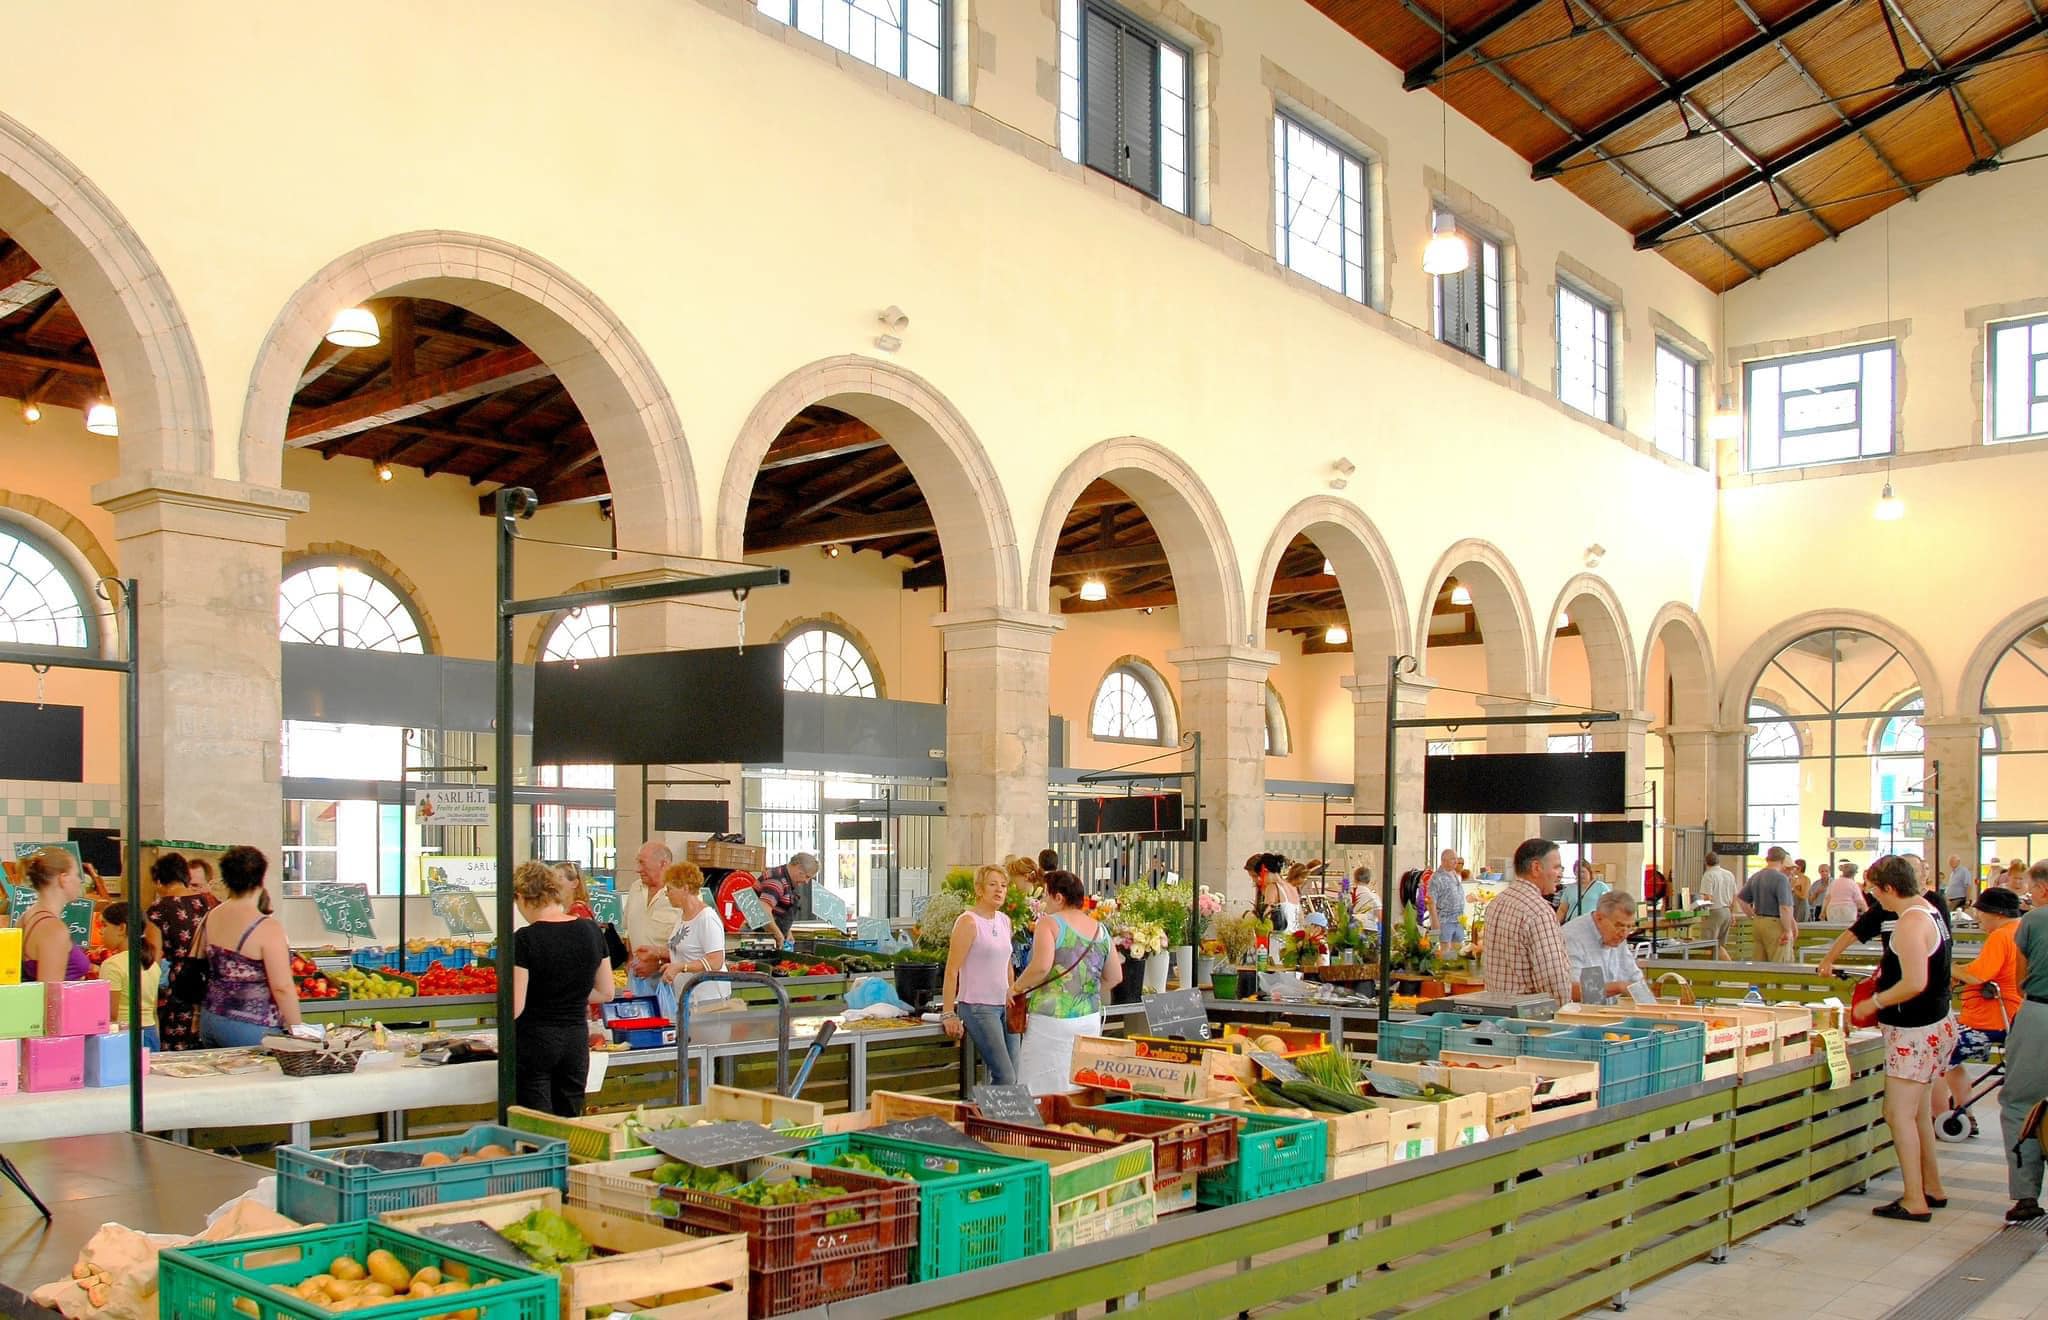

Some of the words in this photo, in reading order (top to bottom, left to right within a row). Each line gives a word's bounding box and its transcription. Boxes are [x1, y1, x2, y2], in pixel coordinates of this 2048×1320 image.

[438, 791, 464, 803] SARL
[466, 791, 485, 803] H.T.
[467, 862, 489, 871] SARL
[1199, 1023, 1210, 1039] €
[1095, 1059, 1181, 1081] PROVENCE
